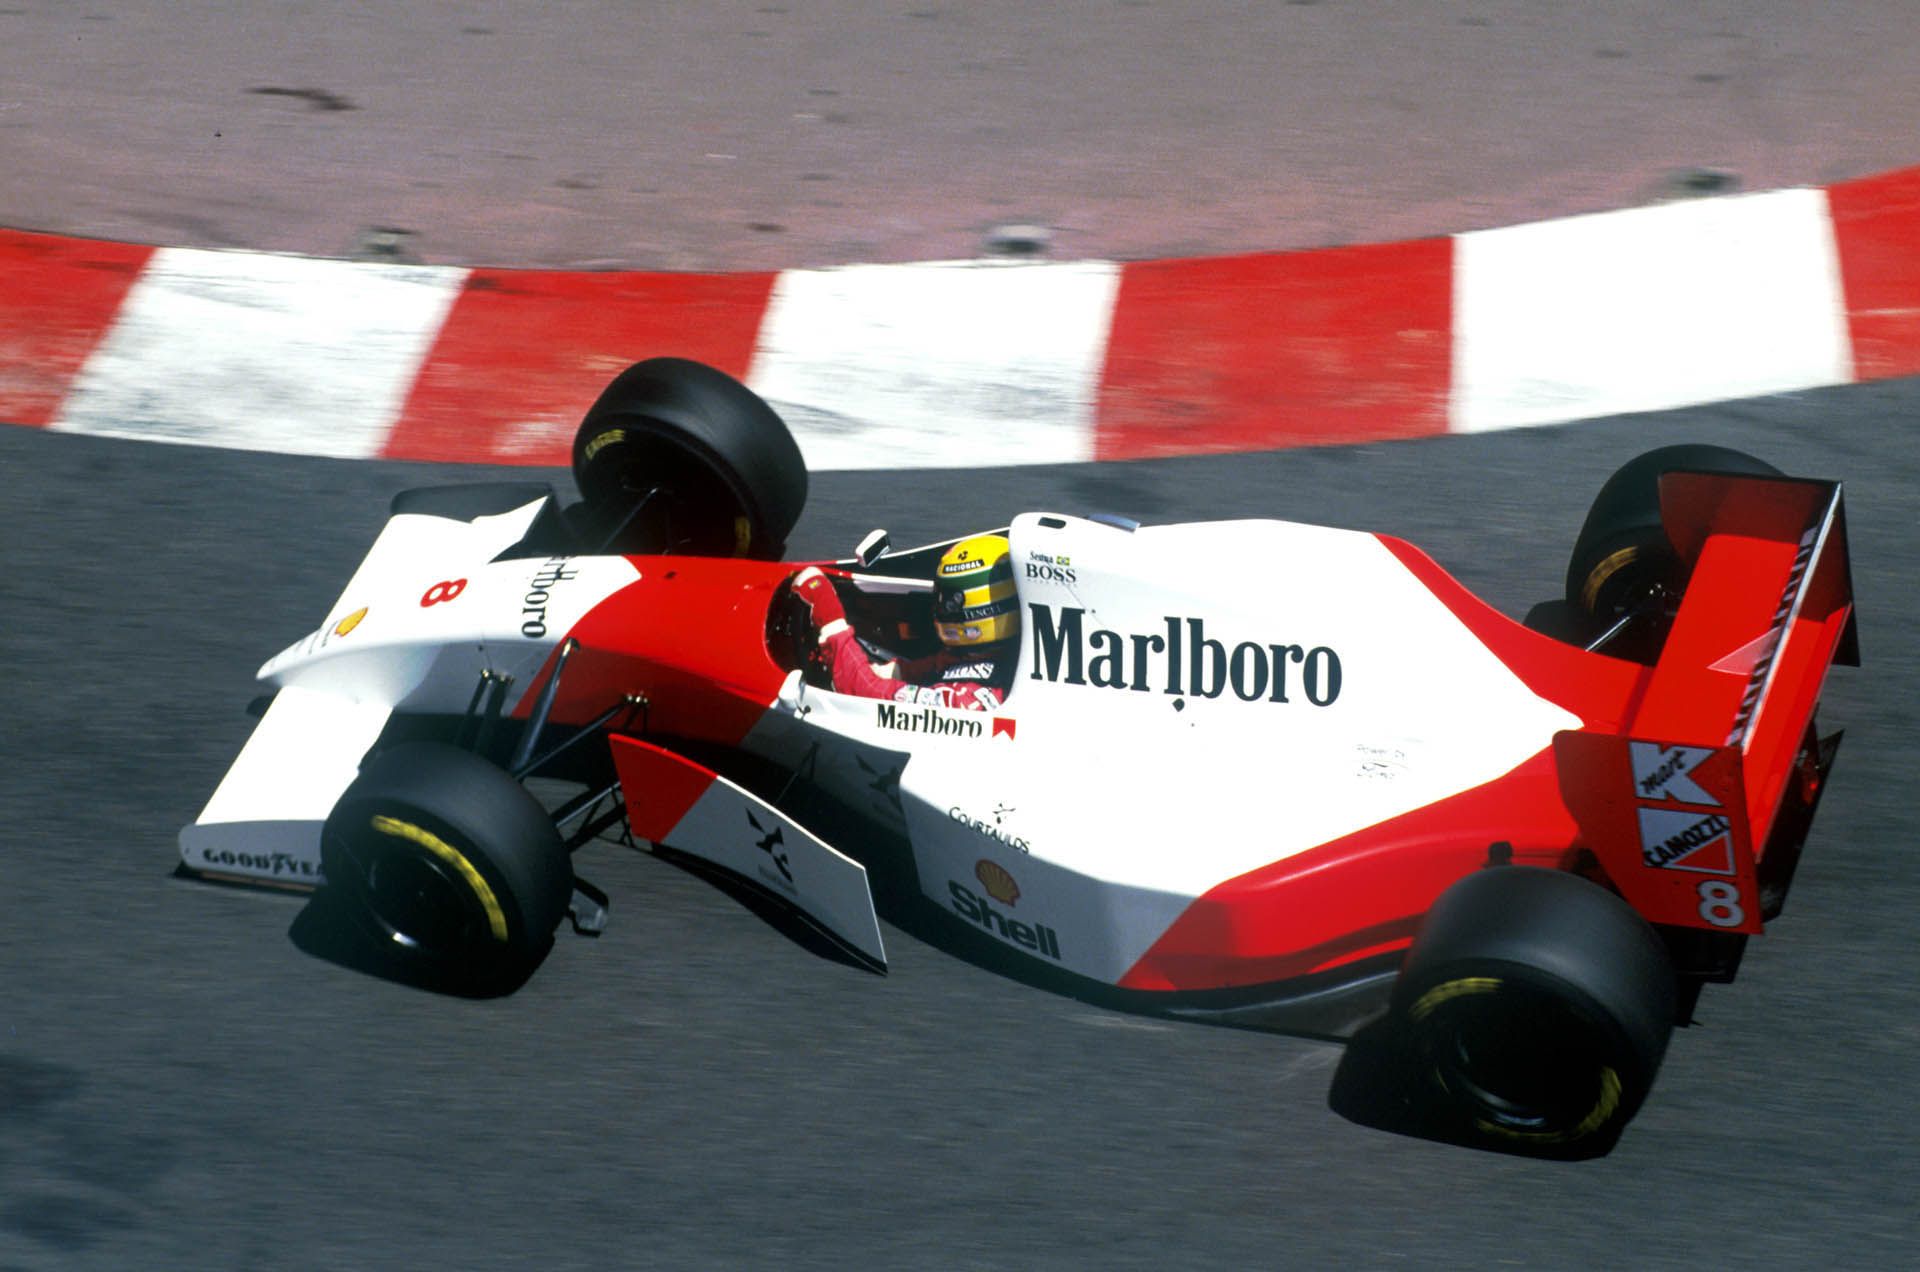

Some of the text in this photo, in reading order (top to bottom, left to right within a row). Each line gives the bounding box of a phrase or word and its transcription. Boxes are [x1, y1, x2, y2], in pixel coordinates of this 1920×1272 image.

[420, 578, 468, 608] 8
[1026, 563, 1076, 583] BOSS
[1028, 602, 1342, 707] Marlboro
[877, 703, 982, 738] Marlboro
[948, 879, 1062, 960] Shell
[1696, 880, 1745, 928] 8
